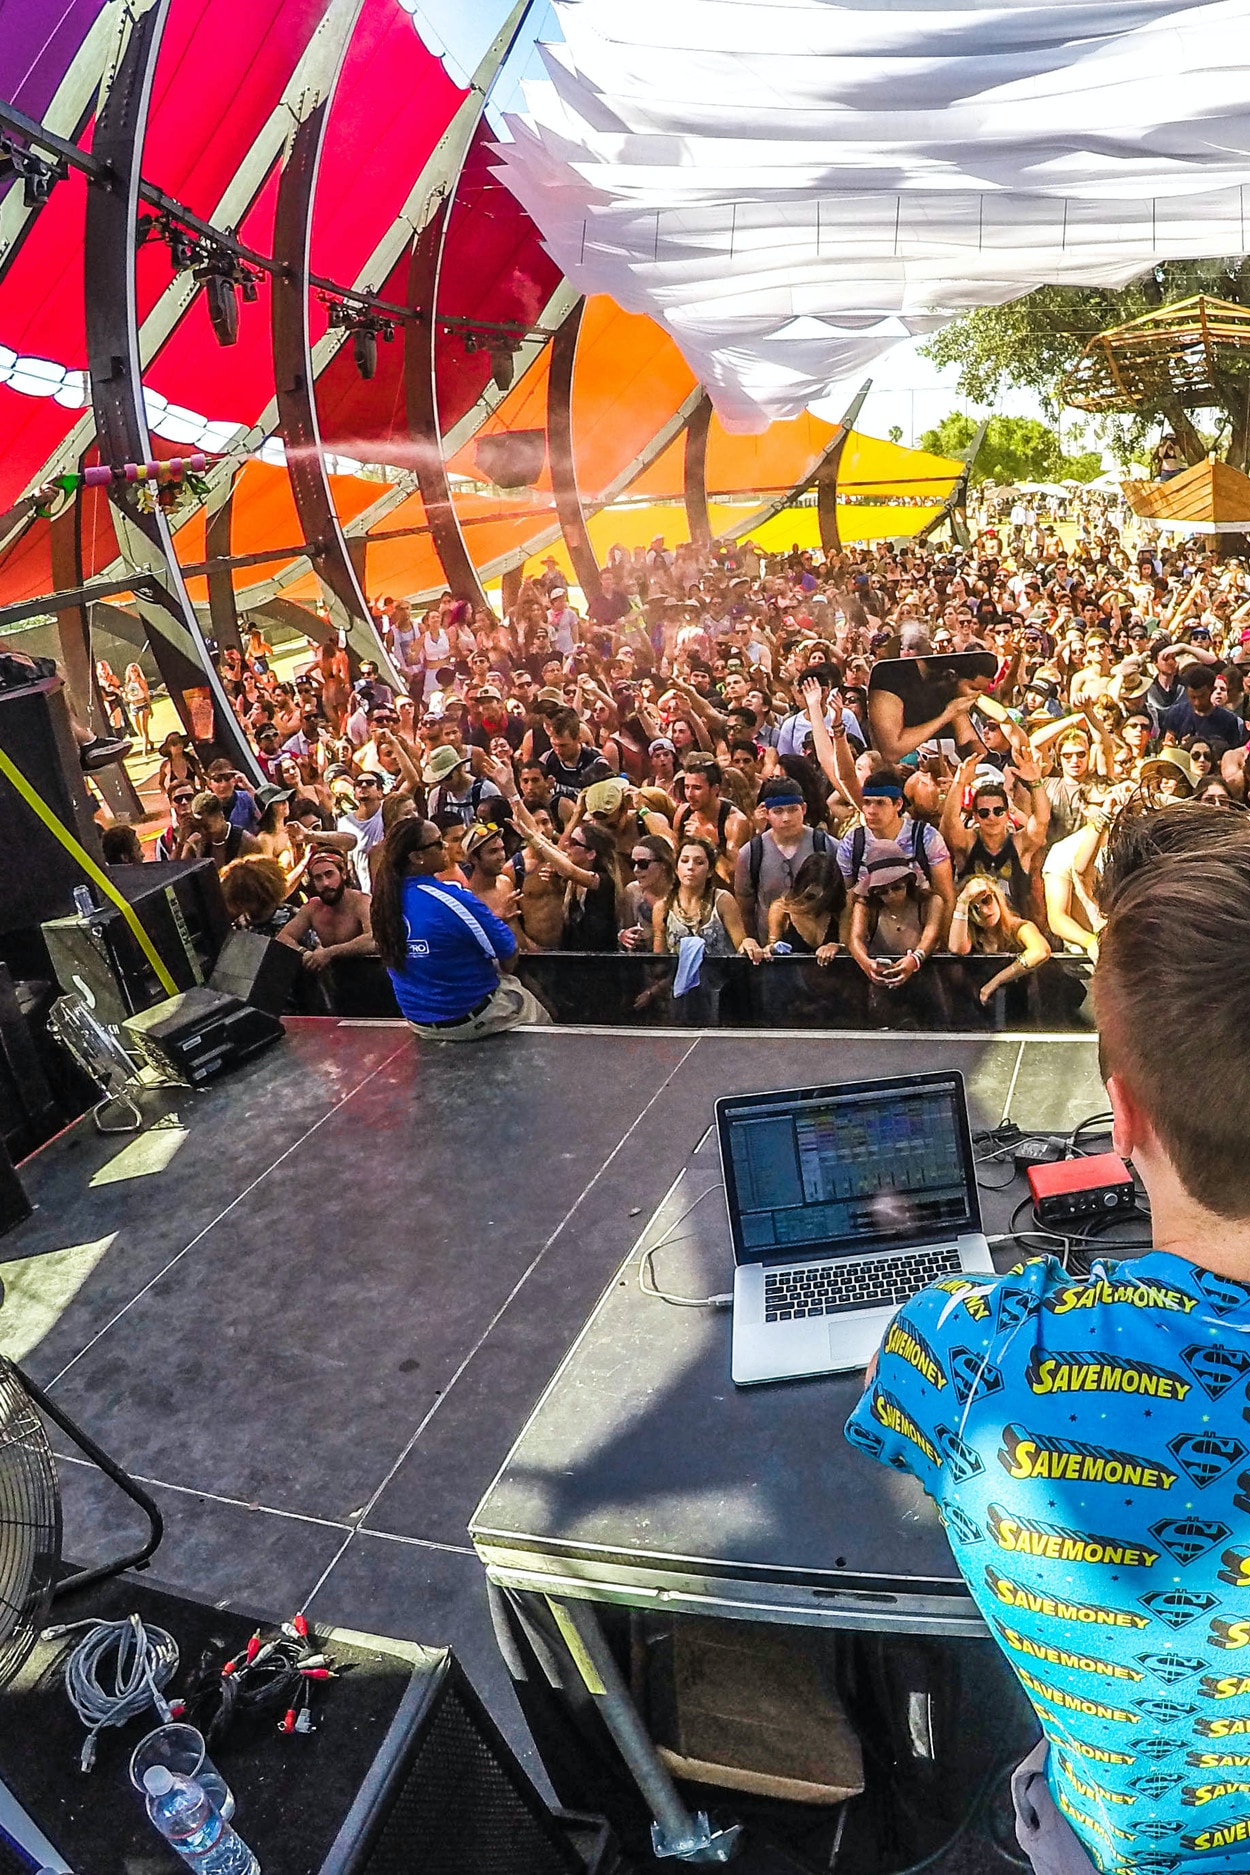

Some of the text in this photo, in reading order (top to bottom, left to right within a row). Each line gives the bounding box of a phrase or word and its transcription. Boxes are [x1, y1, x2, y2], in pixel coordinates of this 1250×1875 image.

[884, 1322, 948, 1391] SAVEMONEY
[1032, 1359, 1192, 1401] SAVEMONEY
[875, 1396, 943, 1468] SAVEMONEY
[1008, 1440, 1178, 1490] SAVEMONEY
[996, 1519, 1161, 1567] SAVEMONEY
[994, 1580, 1152, 1630] SAVEMONEY
[1003, 1629, 1147, 1683] SAVEMONEY
[1017, 1668, 1143, 1724] SAVEMONEY
